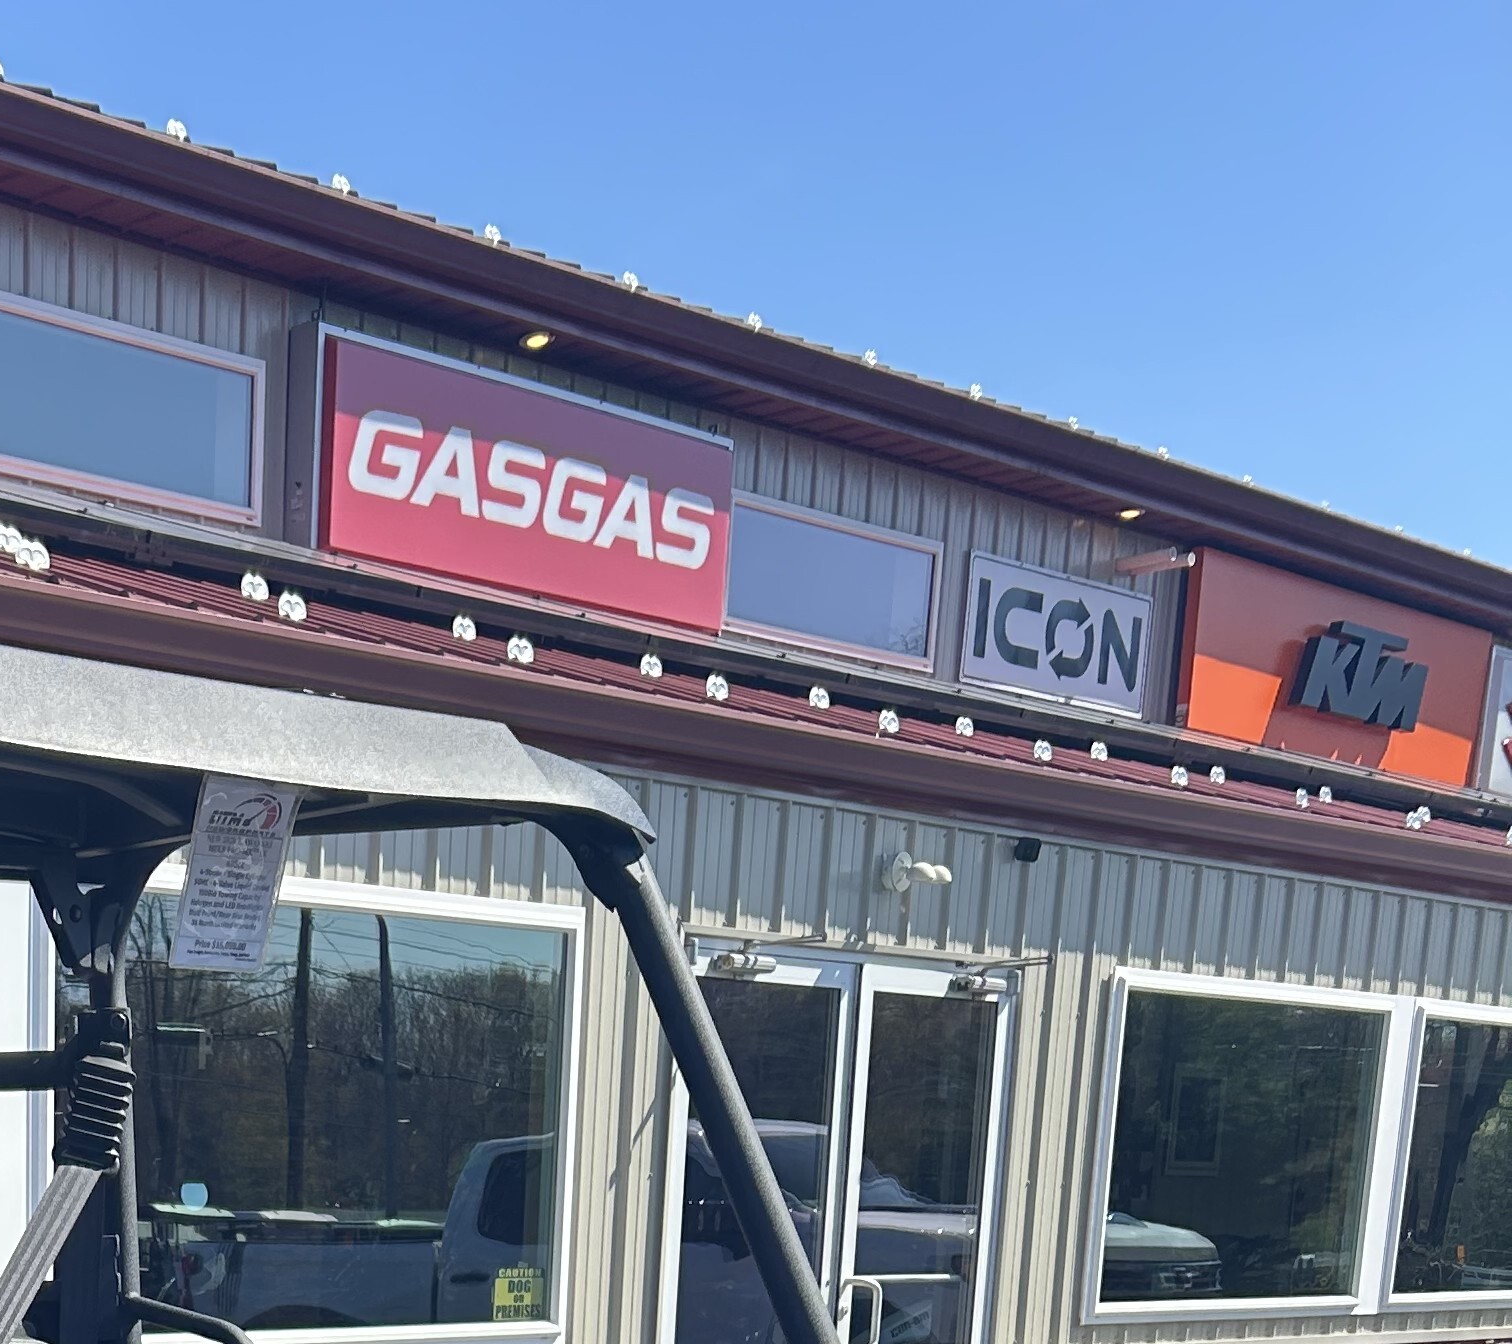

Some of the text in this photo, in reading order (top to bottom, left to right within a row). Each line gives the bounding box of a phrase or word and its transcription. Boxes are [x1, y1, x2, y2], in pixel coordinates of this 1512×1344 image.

[348, 409, 715, 570] GASGAS
[973, 576, 1143, 694] ICON
[1295, 619, 1430, 733] KTM
[498, 1268, 542, 1278] CAUTION
[508, 1280, 531, 1293] DOG
[495, 1304, 541, 1319] PREMISES
